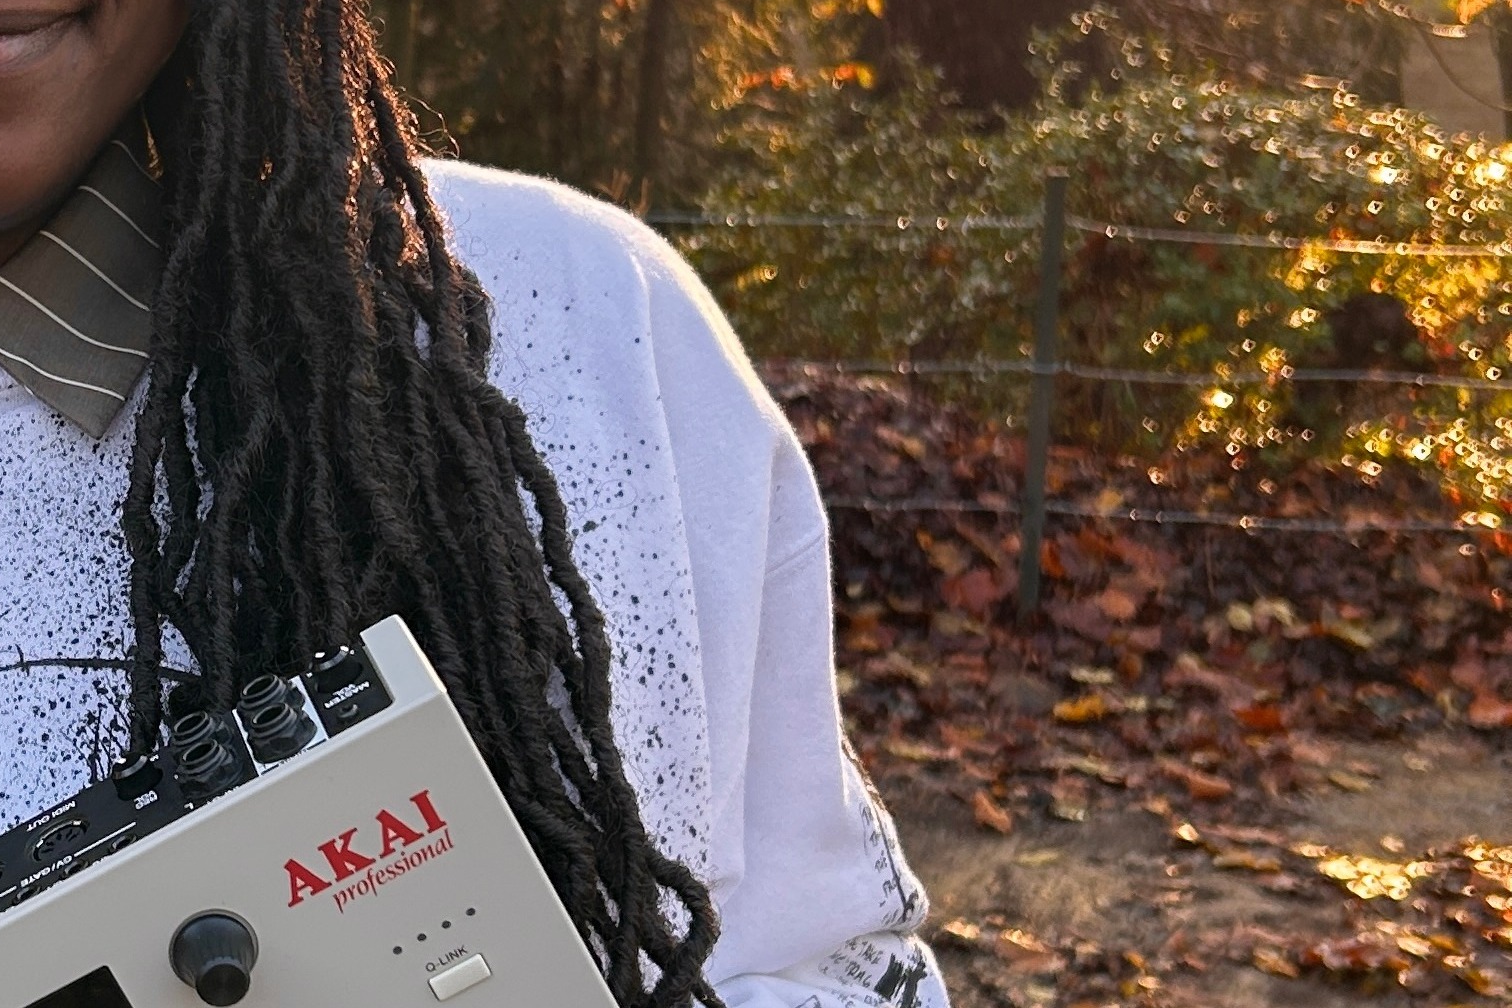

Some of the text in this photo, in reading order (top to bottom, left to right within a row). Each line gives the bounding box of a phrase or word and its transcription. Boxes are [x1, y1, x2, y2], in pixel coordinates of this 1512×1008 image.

[25, 800, 76, 832] MIDI OUT
[284, 789, 447, 907] AKAI
[20, 855, 74, 886] CV/GATE
[332, 829, 455, 913] professional
[425, 944, 469, 973] Q-LINK
